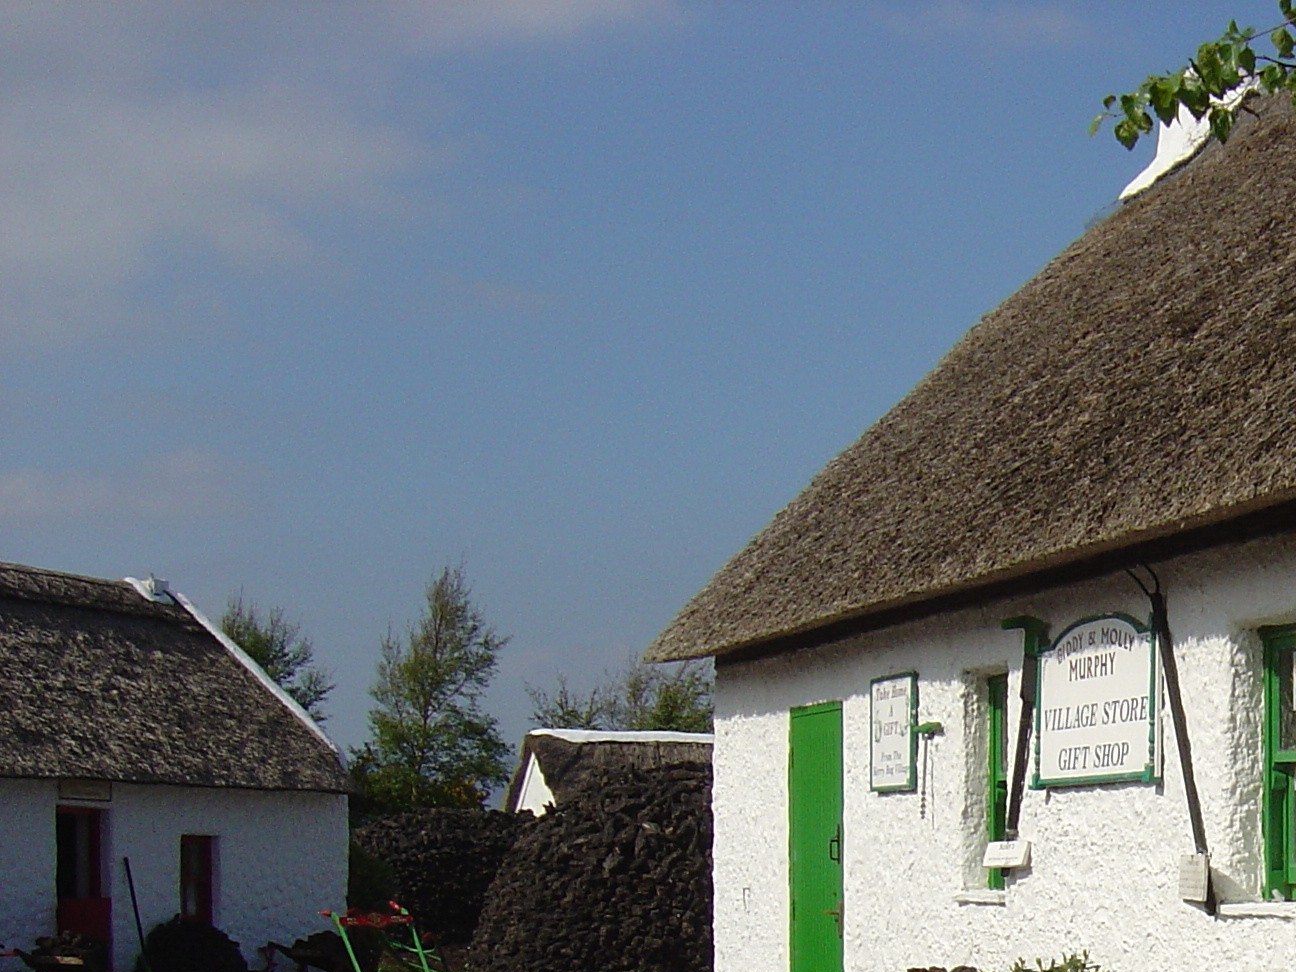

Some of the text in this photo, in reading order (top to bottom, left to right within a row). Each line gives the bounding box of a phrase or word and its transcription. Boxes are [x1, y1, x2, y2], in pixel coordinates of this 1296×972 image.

[1057, 627, 1136, 665] BIDDY & MOLLY
[1068, 652, 1116, 682] MURPHY
[1044, 697, 1148, 731] VILLAGE STORE
[1058, 742, 1130, 771] GIFT SHOP
